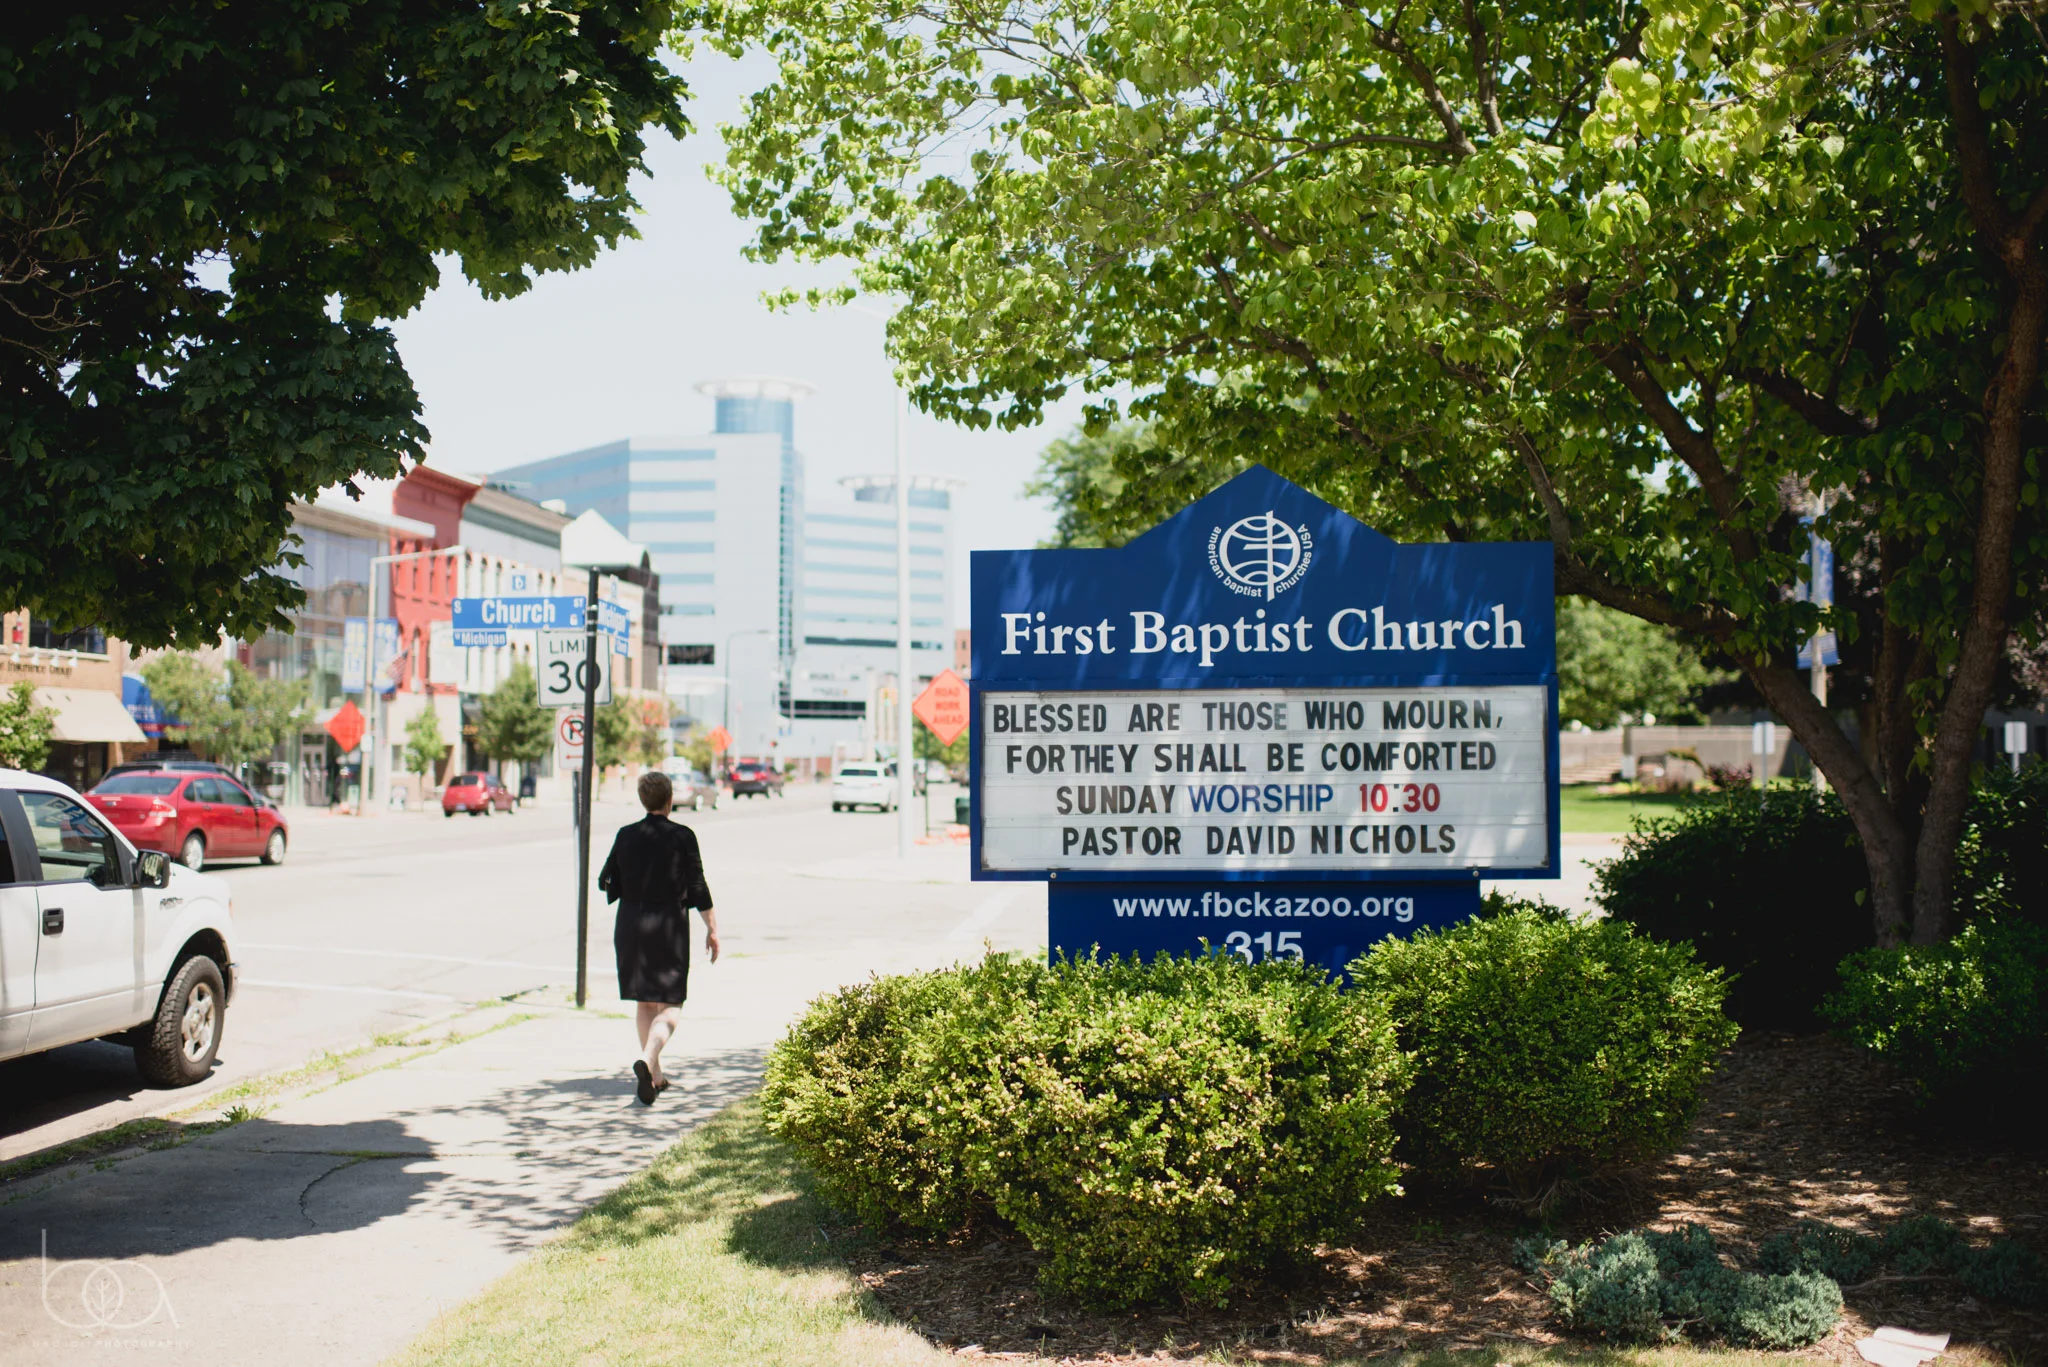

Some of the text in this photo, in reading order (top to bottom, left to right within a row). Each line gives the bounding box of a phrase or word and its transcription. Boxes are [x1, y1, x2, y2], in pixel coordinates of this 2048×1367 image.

[1208, 523, 1313, 598] american baptist churches USA
[454, 600, 462, 614] S
[481, 599, 556, 625] Church
[550, 640, 587, 654] LIMI
[1001, 603, 1526, 667] First Baptist Church
[548, 660, 602, 694] 30
[935, 687, 960, 697] ROAD
[932, 714, 965, 724] AHEAD
[993, 700, 1503, 732] BLESSED ARE THOSE WHO MOURN,
[1154, 743, 1247, 773] SHALL
[1267, 743, 1304, 772] BE
[1321, 741, 1497, 771] COMFORTED
[1056, 783, 1441, 815] SUNDAY WORSHIP 10:30
[1062, 824, 1456, 856] PASTOR DAVID NICHOLS
[1113, 891, 1415, 923] www.fbckazoo.org
[1226, 930, 1304, 968] 315
